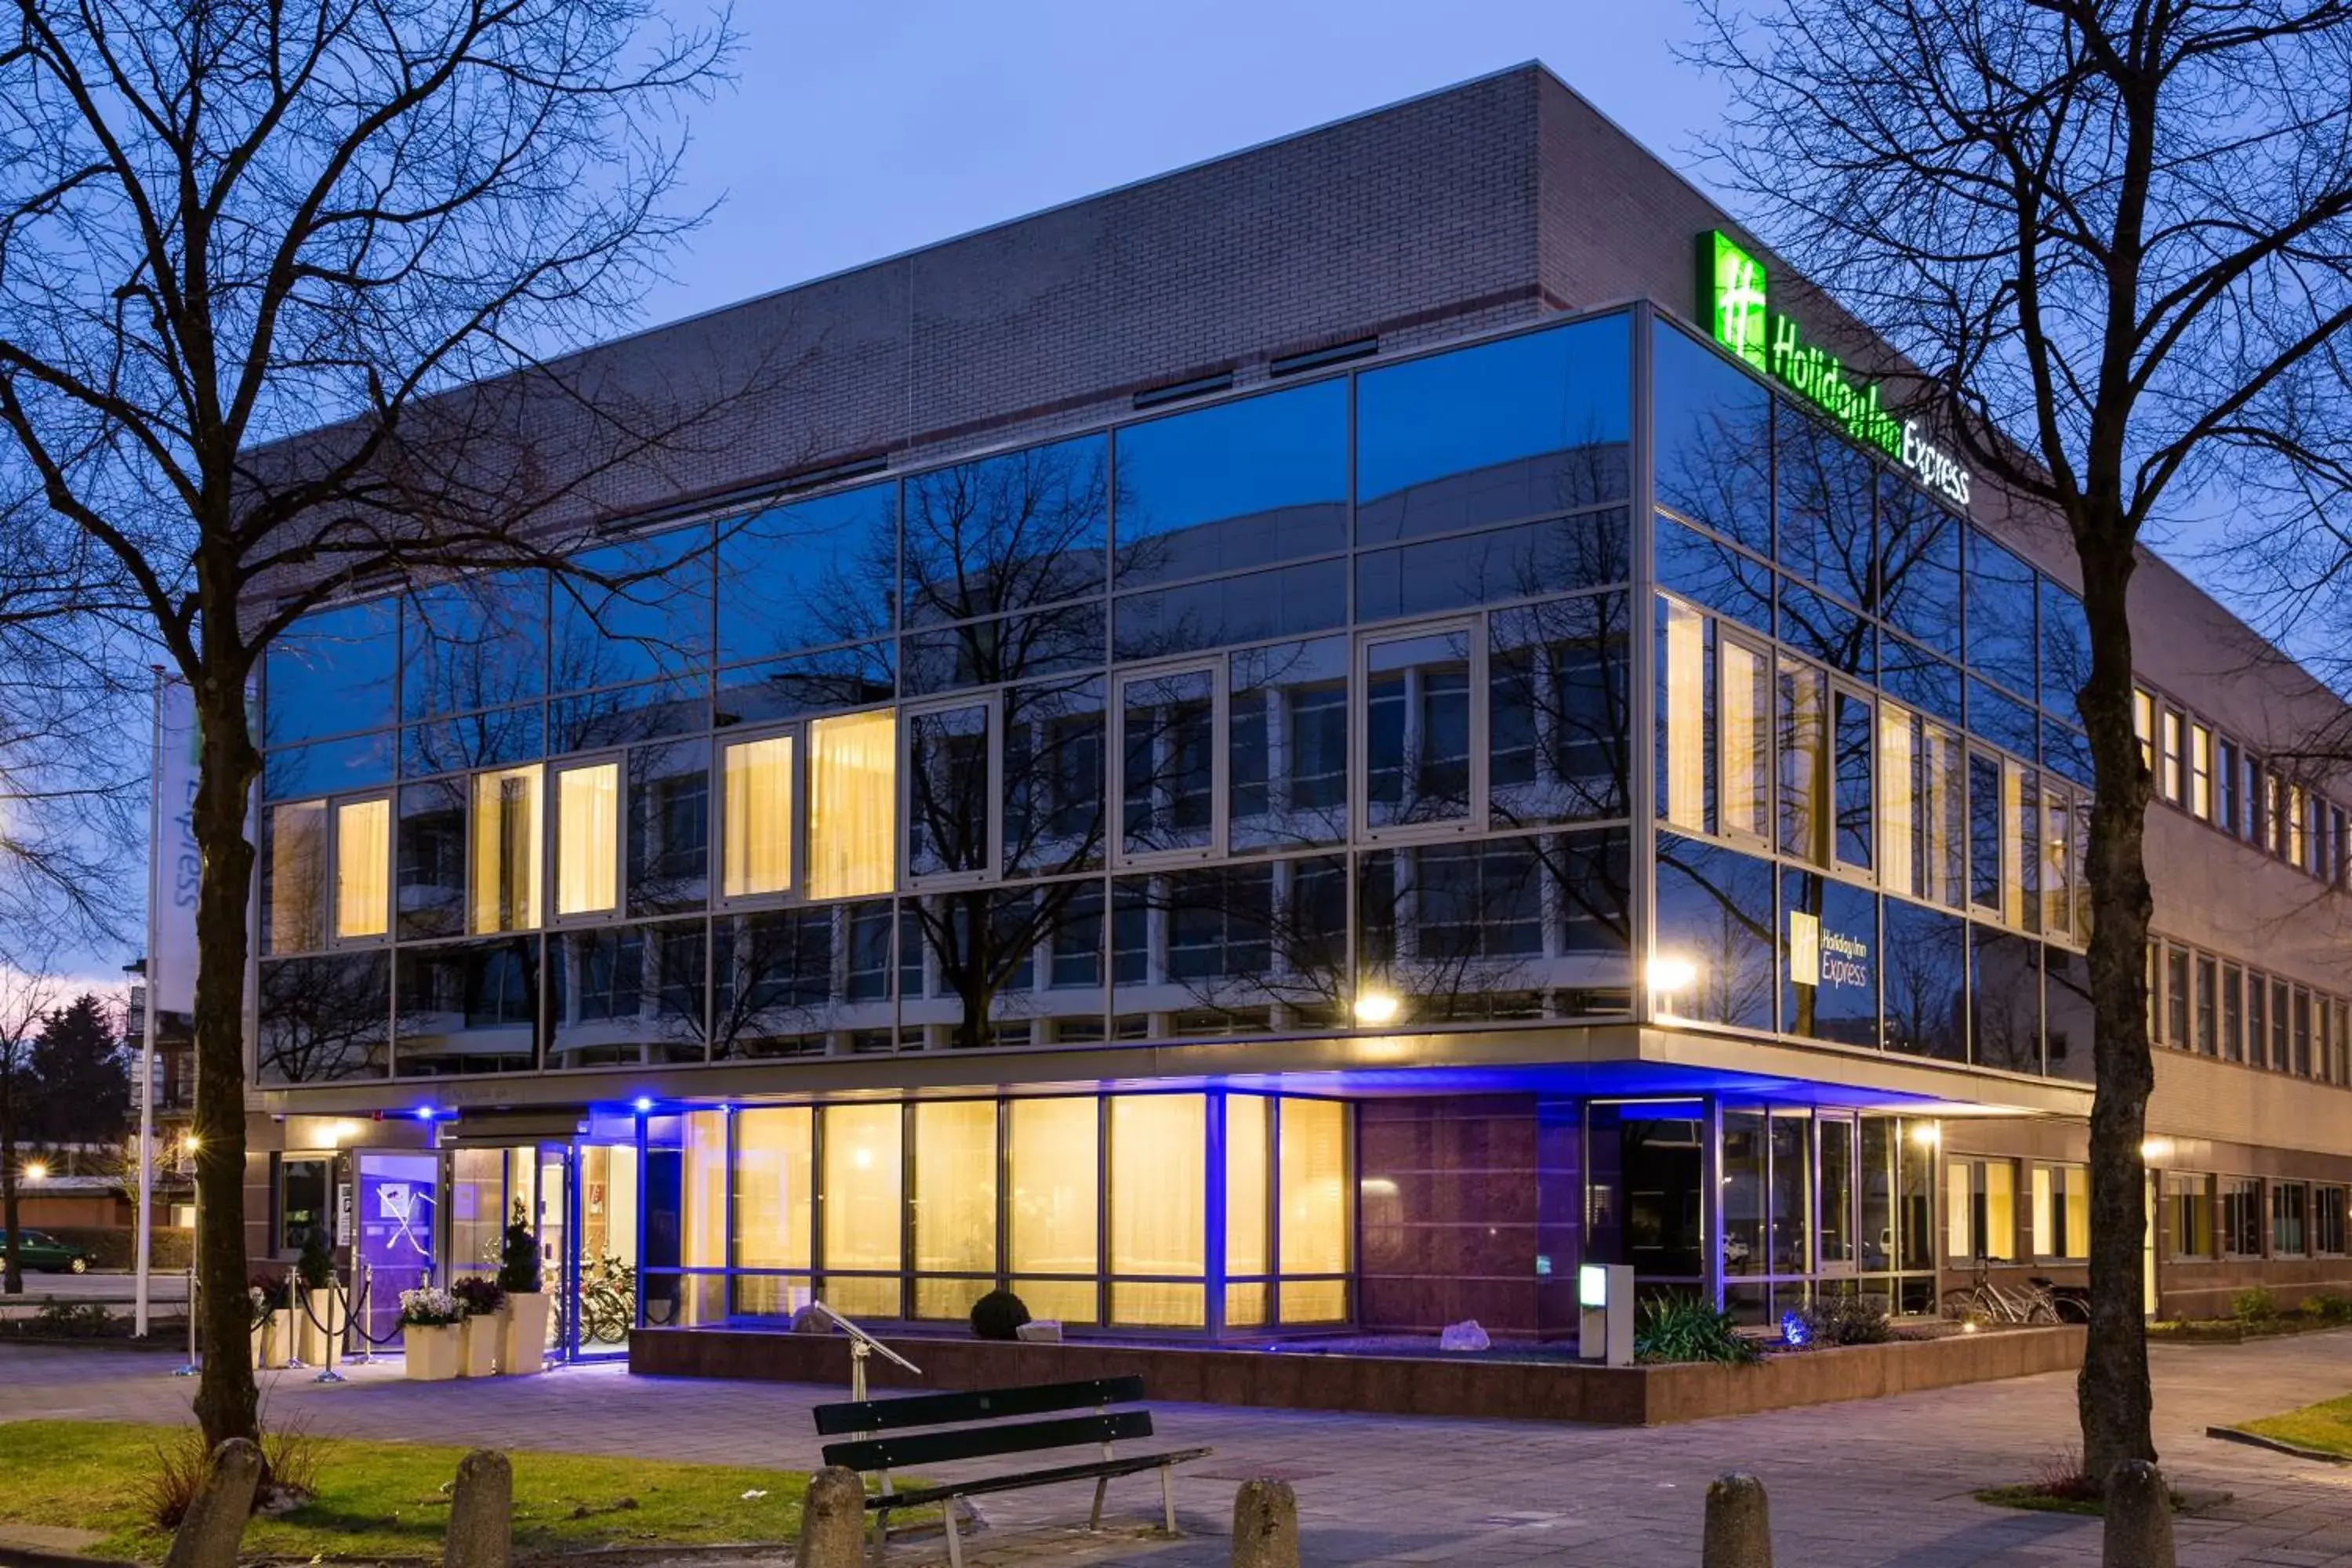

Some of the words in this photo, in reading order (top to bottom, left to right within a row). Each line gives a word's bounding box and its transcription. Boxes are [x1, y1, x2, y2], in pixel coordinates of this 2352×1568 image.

[1773, 314, 1867, 439] Holiday
[1903, 419, 1969, 504] Express
[1822, 928, 1853, 960] Holiday
[1853, 936, 1867, 957] Inn
[1822, 951, 1867, 989] Express
